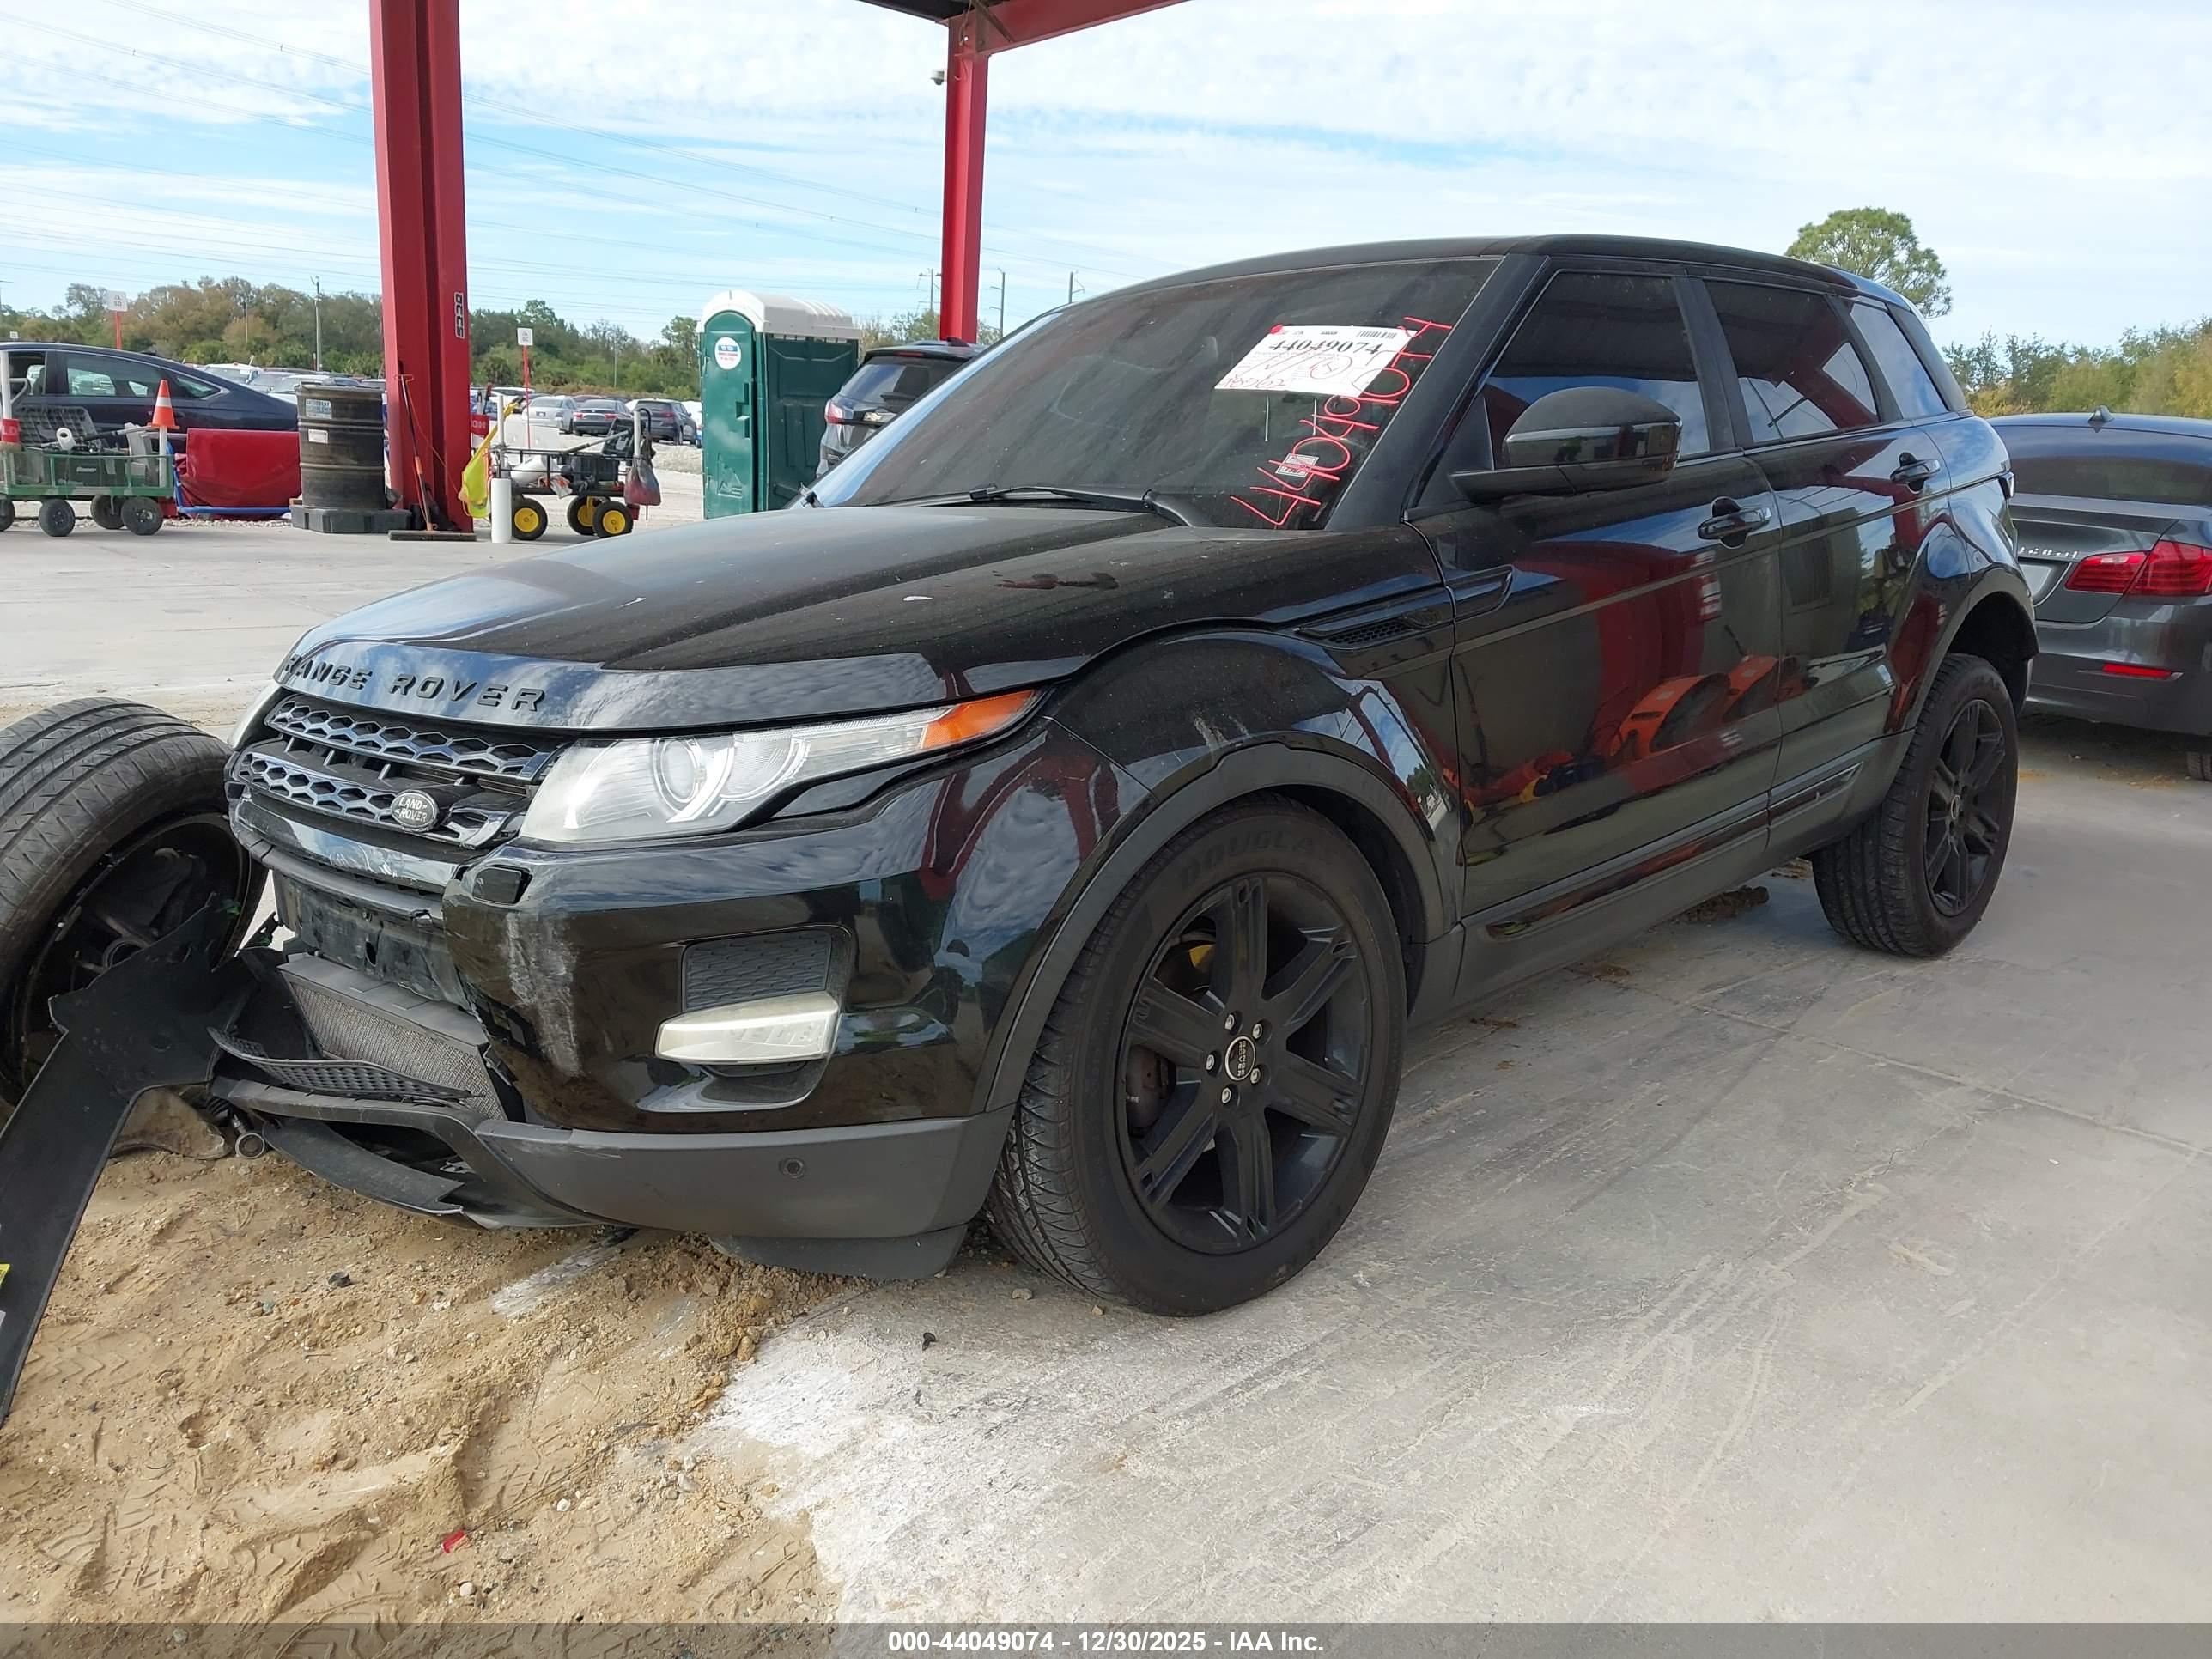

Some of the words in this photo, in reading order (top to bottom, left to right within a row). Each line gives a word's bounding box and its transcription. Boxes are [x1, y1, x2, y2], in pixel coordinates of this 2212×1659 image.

[1269, 338, 1384, 355] 44049074
[282, 655, 373, 691] RANGE
[389, 673, 546, 712] ROVER
[398, 796, 423, 810] LAND
[398, 808, 428, 822] ROVER
